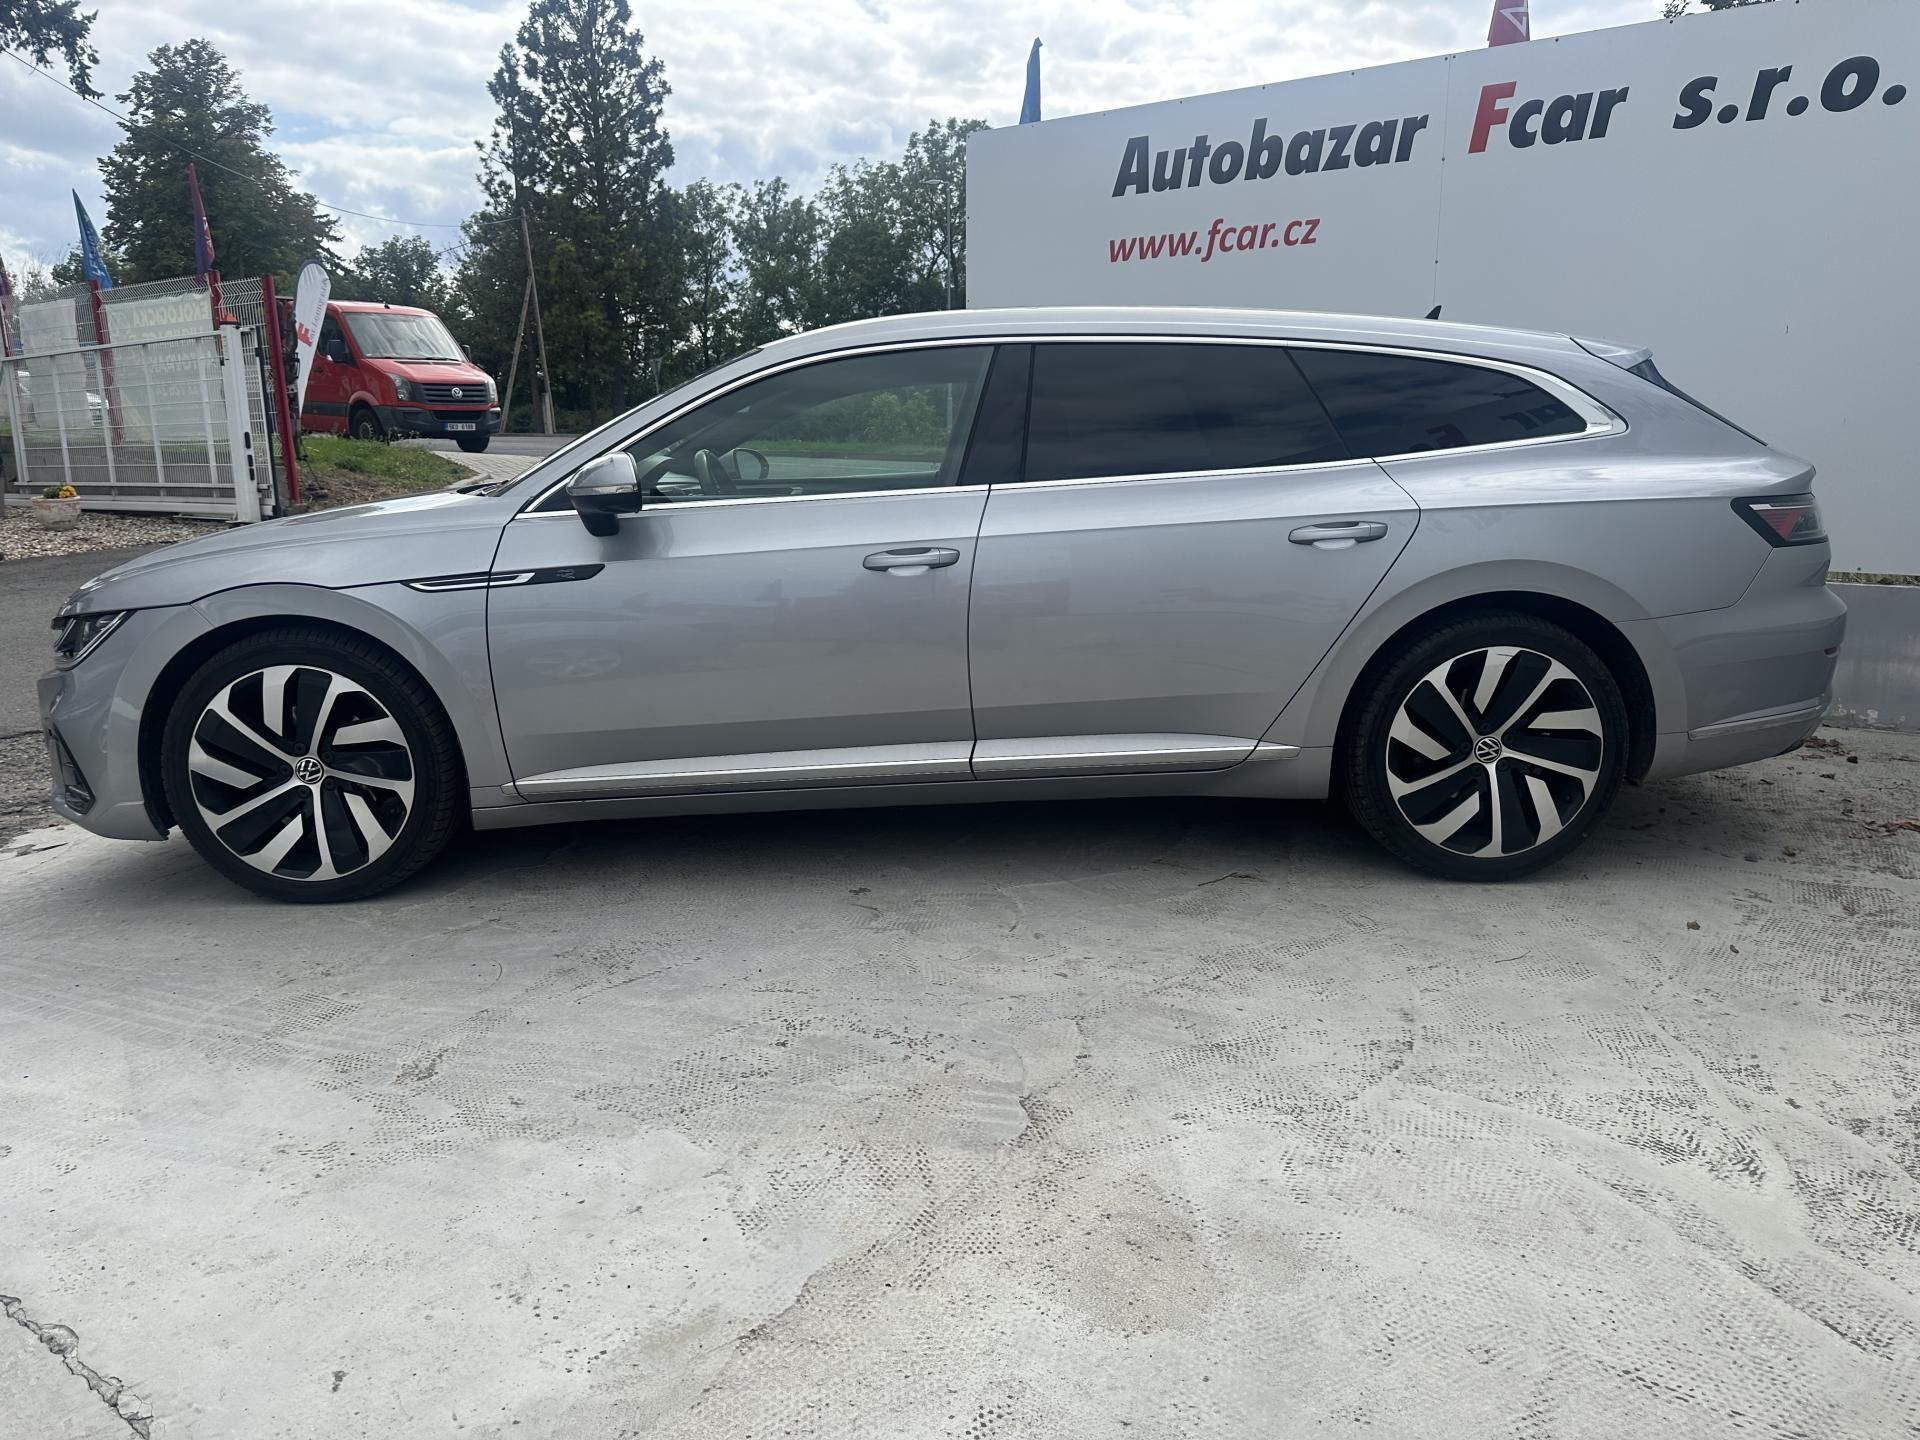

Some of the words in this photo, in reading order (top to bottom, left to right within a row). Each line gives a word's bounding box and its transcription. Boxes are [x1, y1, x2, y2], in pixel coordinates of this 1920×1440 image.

[1111, 115, 1430, 198] Autobazar
[1467, 81, 1630, 154] Fcar
[1672, 55, 1907, 130] s.r.o.
[1109, 218, 1324, 263] www.fcar.cz
